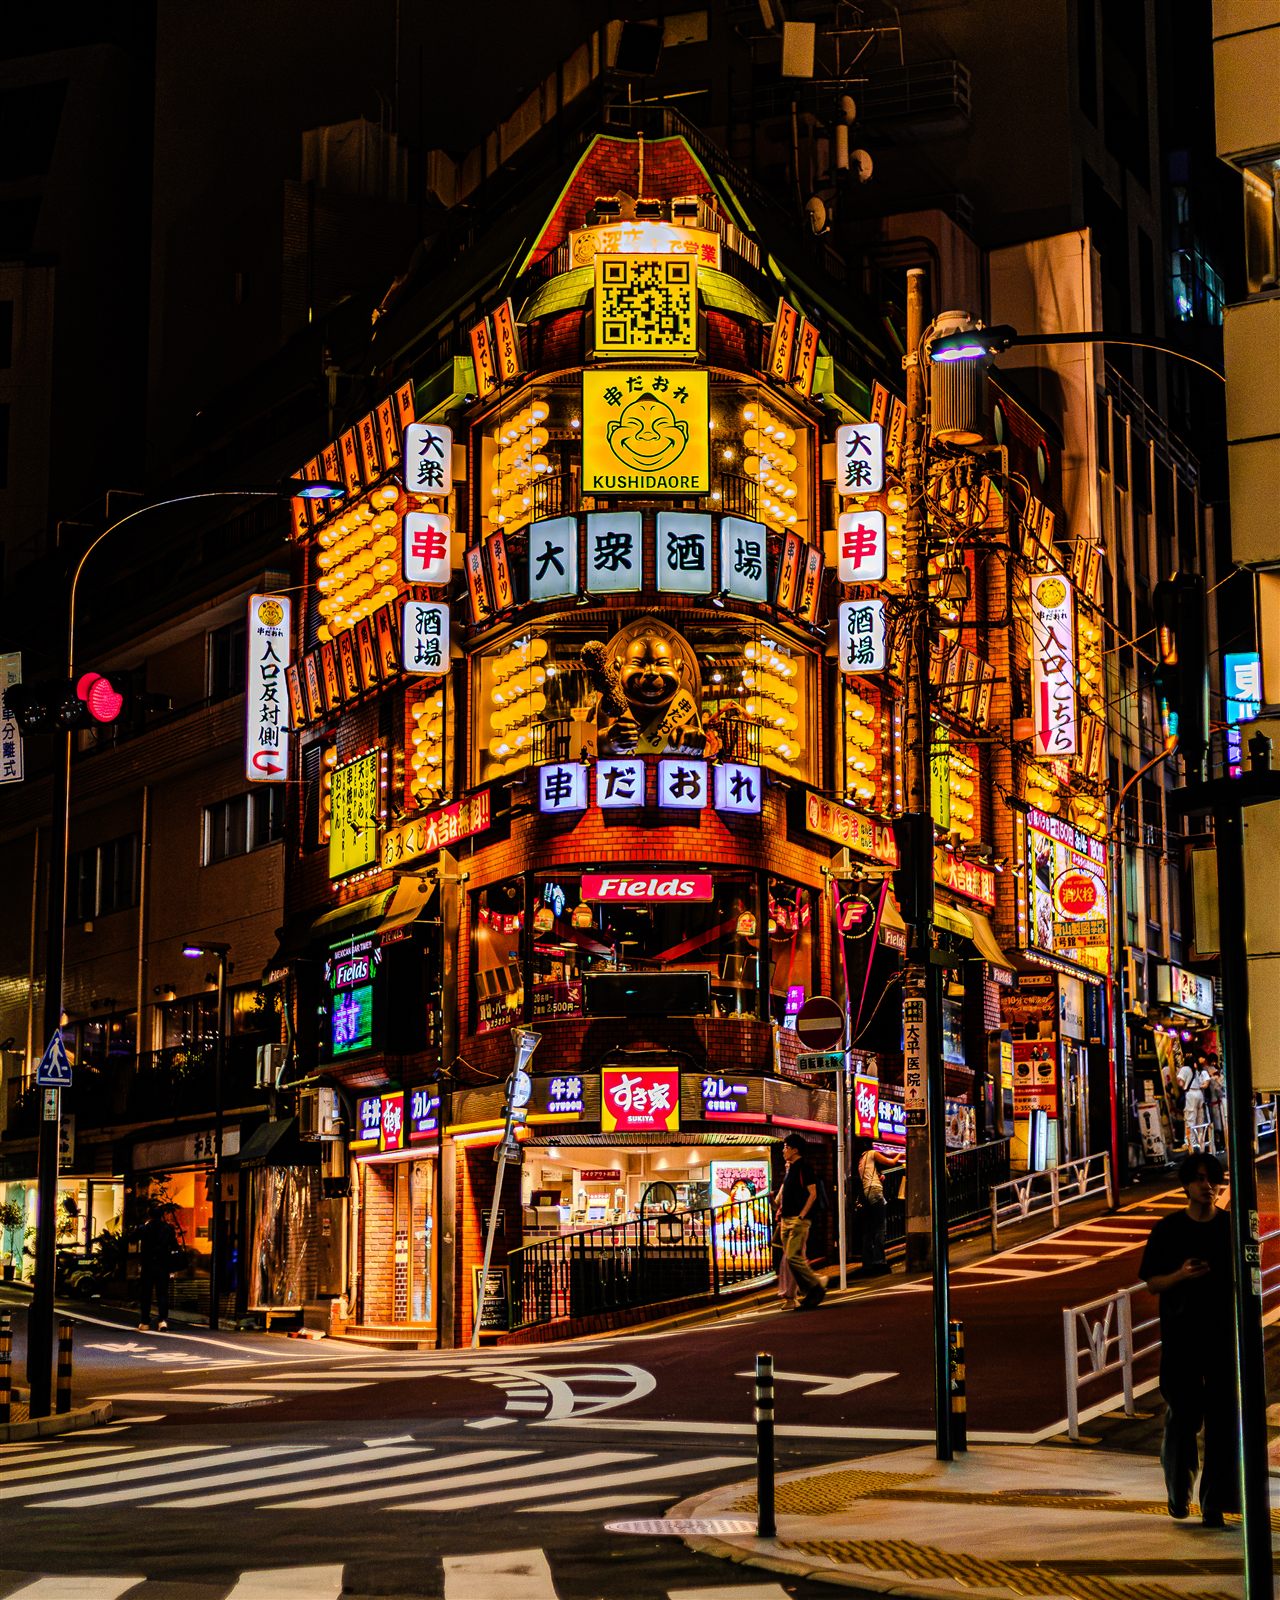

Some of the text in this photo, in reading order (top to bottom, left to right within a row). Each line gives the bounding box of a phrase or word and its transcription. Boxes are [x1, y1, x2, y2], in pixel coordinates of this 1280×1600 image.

[603, 375, 689, 407] 串だおれ
[416, 429, 444, 488] 大衆
[845, 430, 872, 487] 大衆
[593, 475, 700, 488] KUSHIDAORE
[411, 523, 447, 570] 串
[535, 531, 763, 582] 大衆酒場
[842, 523, 877, 570] 串
[493, 538, 509, 601] 串カツ
[781, 539, 795, 600] 串カツ
[414, 606, 444, 667] 酒場
[847, 606, 876, 665] 酒場
[259, 640, 282, 748] 入口反対側
[324, 648, 340, 702] ハイボー
[1039, 626, 1073, 751] 入口こちら
[647, 698, 690, 747] 串だおれ
[544, 765, 757, 807] 串だおれ
[598, 877, 696, 896] Fields
[1062, 887, 1095, 903] 消火栓
[337, 961, 368, 984] Fields
[799, 1056, 844, 1071] 自転車を除く
[412, 1090, 440, 1119] カレー
[551, 1078, 581, 1099] 牛丼
[610, 1074, 671, 1114] すき家
[703, 1078, 748, 1098] カレー
[856, 1083, 876, 1121] すき家
[362, 1098, 381, 1128] 牛丼
[383, 1101, 401, 1134] すき家
